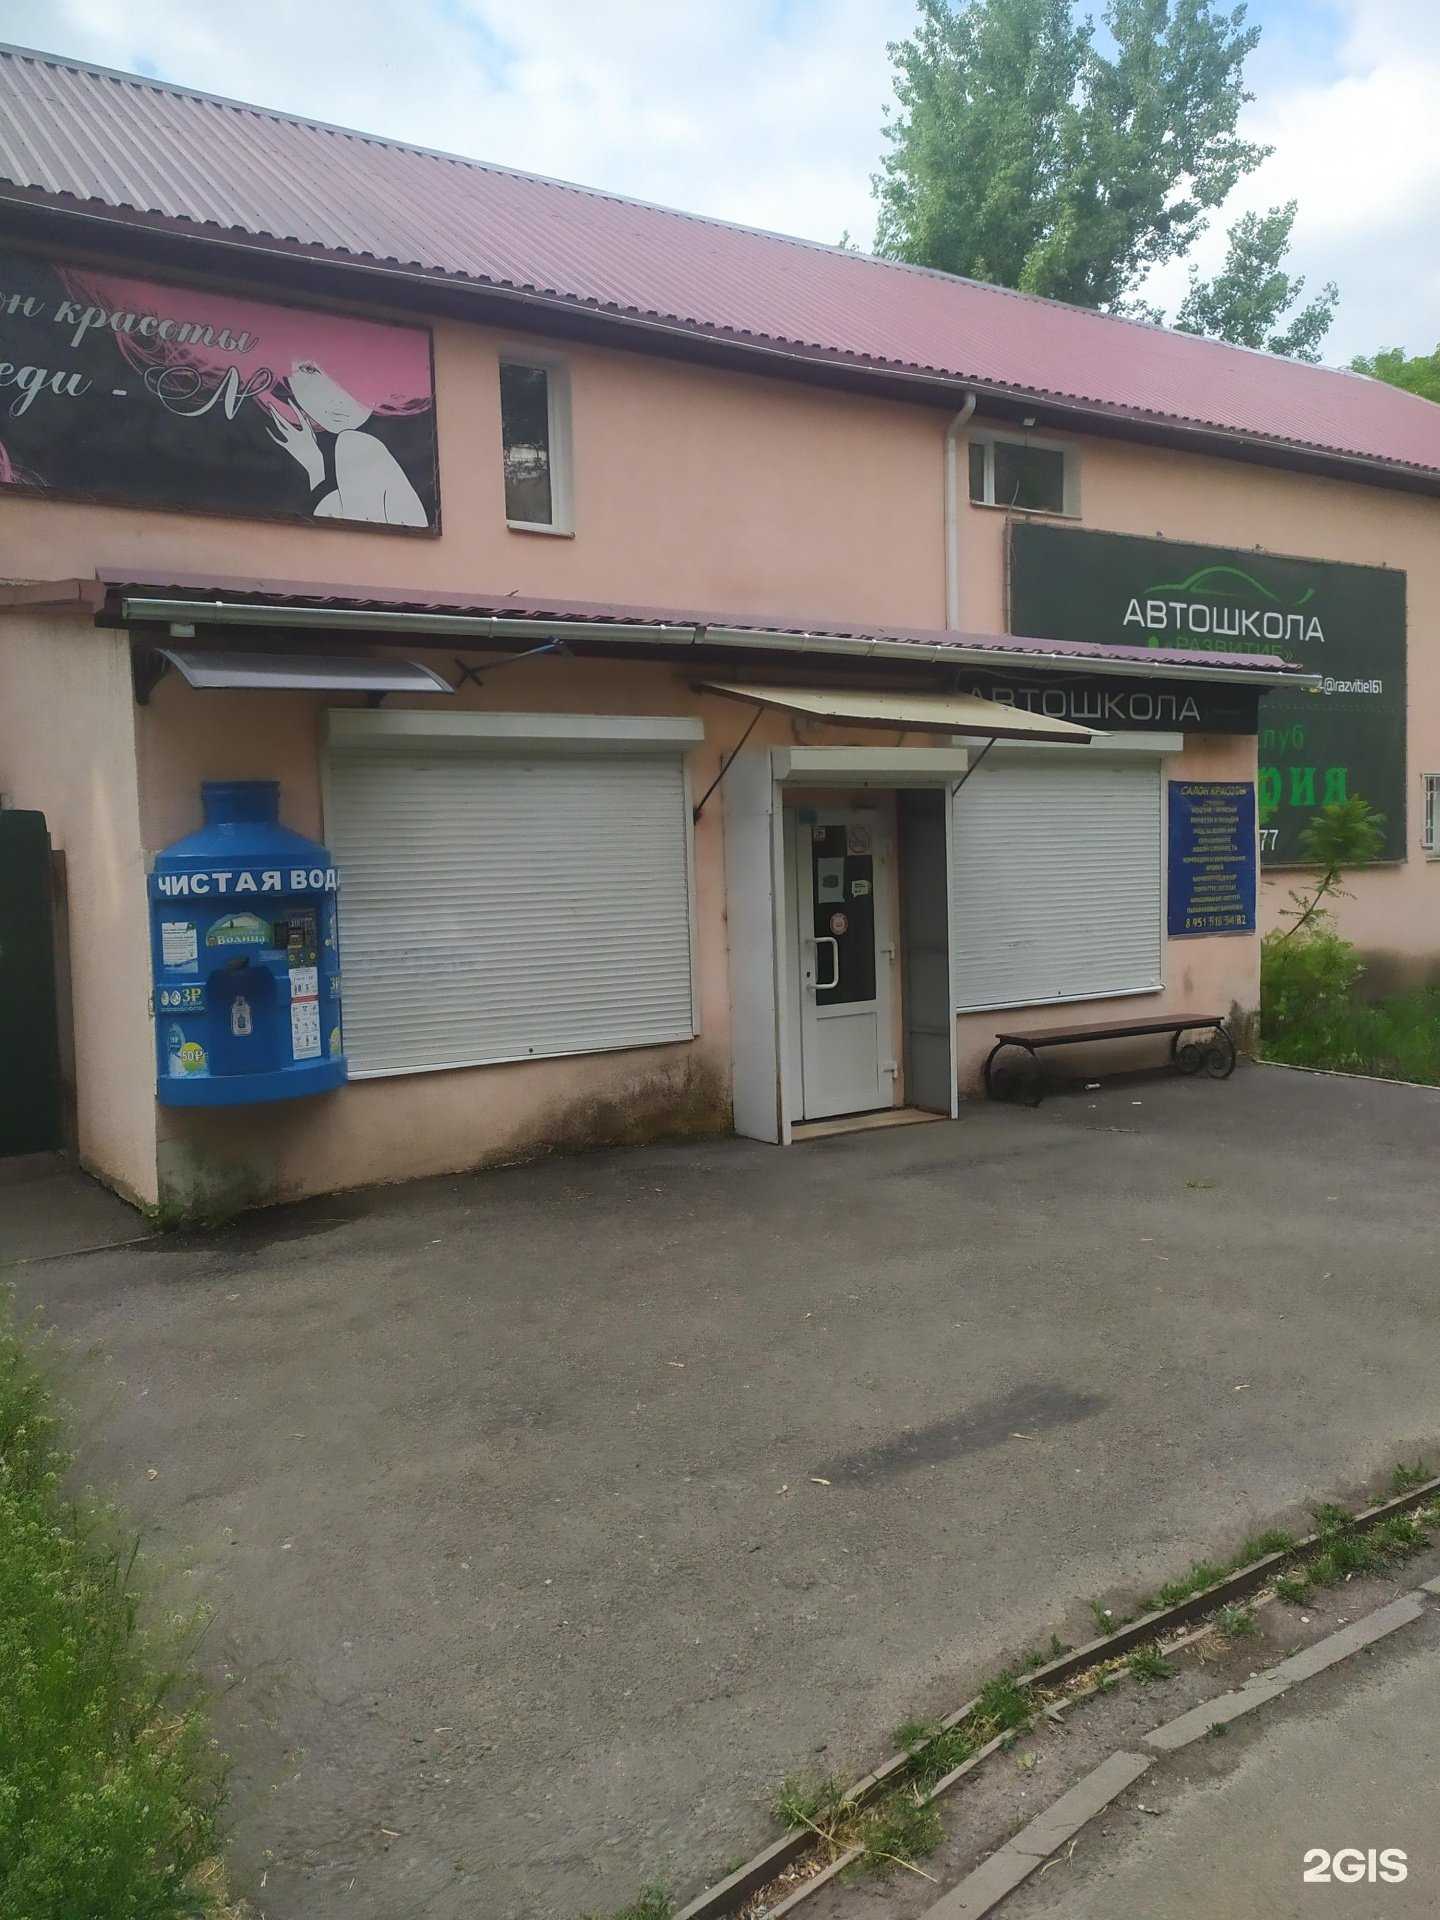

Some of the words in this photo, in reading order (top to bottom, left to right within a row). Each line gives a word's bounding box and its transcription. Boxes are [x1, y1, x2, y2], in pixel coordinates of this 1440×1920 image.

[54, 300, 259, 353] красоты
[144, 366, 272, 420] N
[1122, 598, 1325, 642] АВТОШКОЛА
[1323, 677, 1383, 695] @razvitie161
[1260, 829, 1279, 851] 77
[158, 871, 281, 896] ЧИСТАЯ
[290, 869, 340, 892] ВОД
